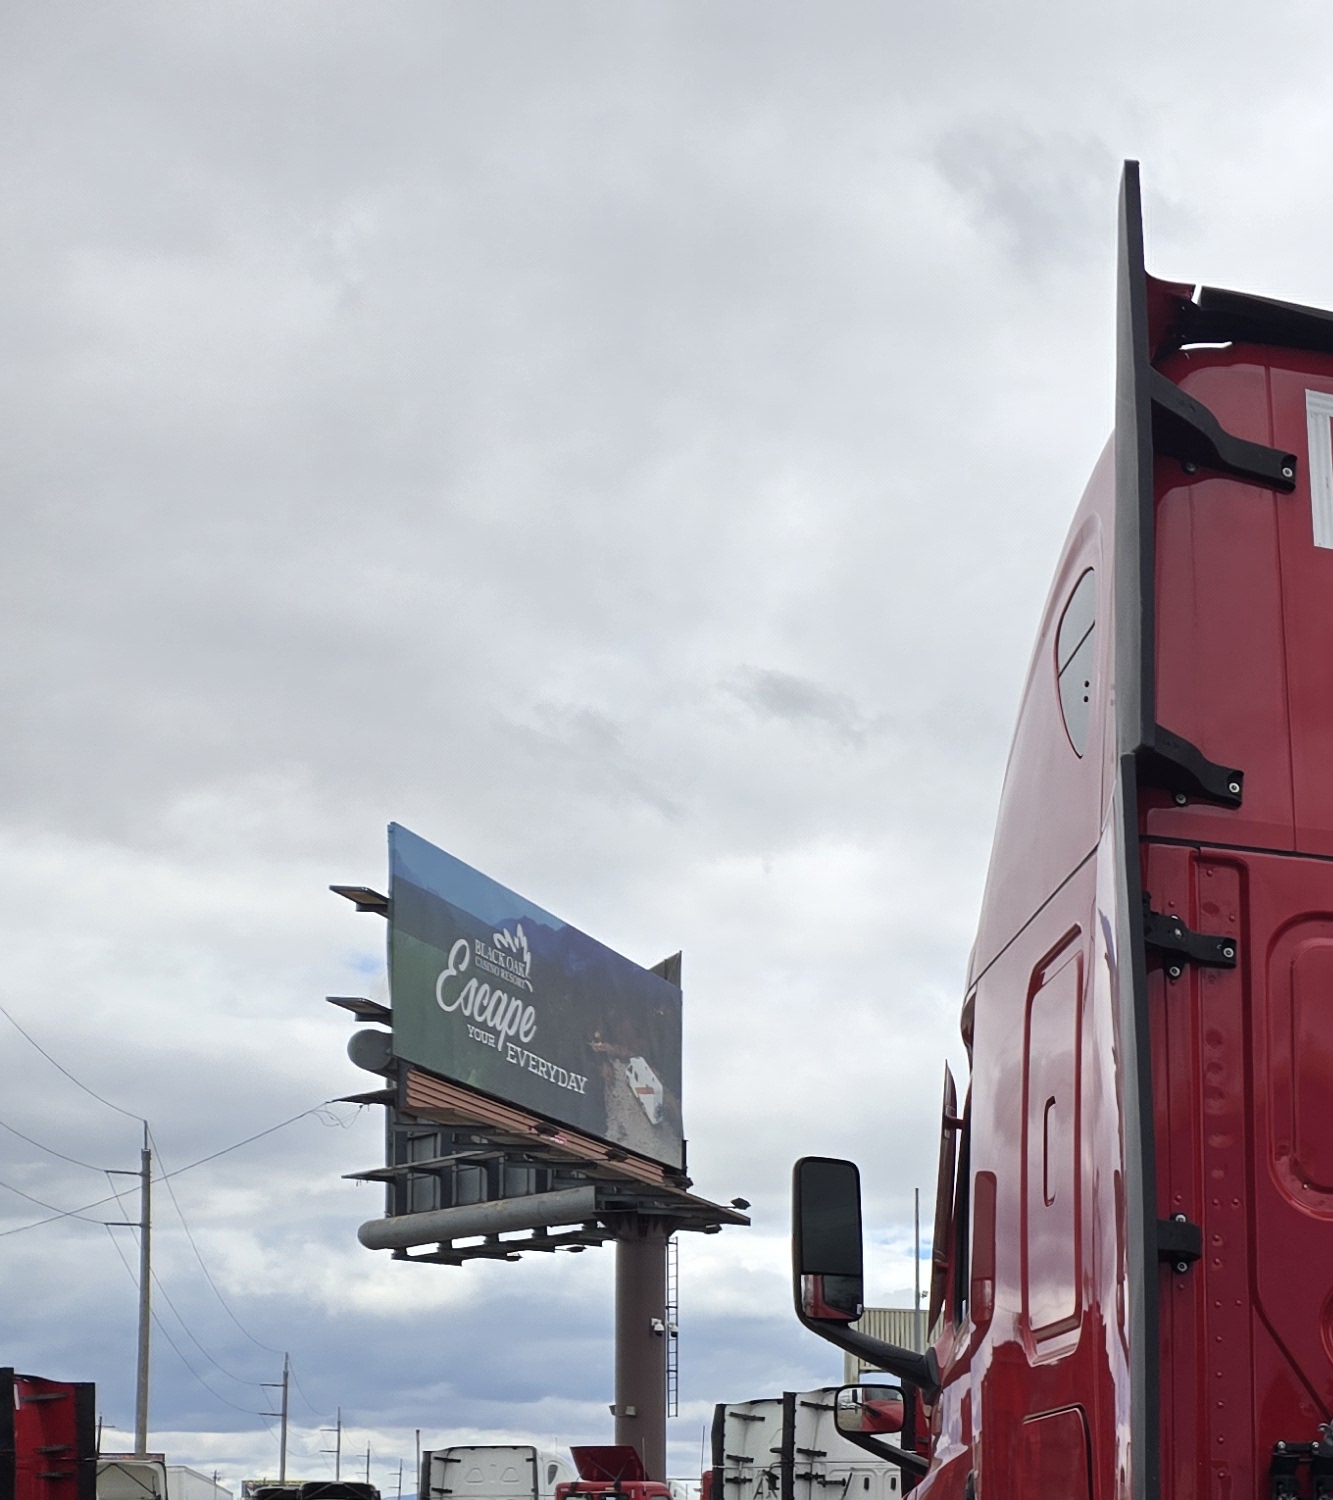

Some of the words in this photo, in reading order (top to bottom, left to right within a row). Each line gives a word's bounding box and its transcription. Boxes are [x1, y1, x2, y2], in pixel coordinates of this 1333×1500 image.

[474, 938, 506, 969] BLACK
[506, 956, 527, 978] OAK
[474, 955, 500, 977] CASINO
[500, 970, 527, 989] RESORT
[436, 938, 537, 1052] Escape
[467, 1023, 496, 1048] YOUR
[506, 1041, 588, 1095] EVERYDAY
